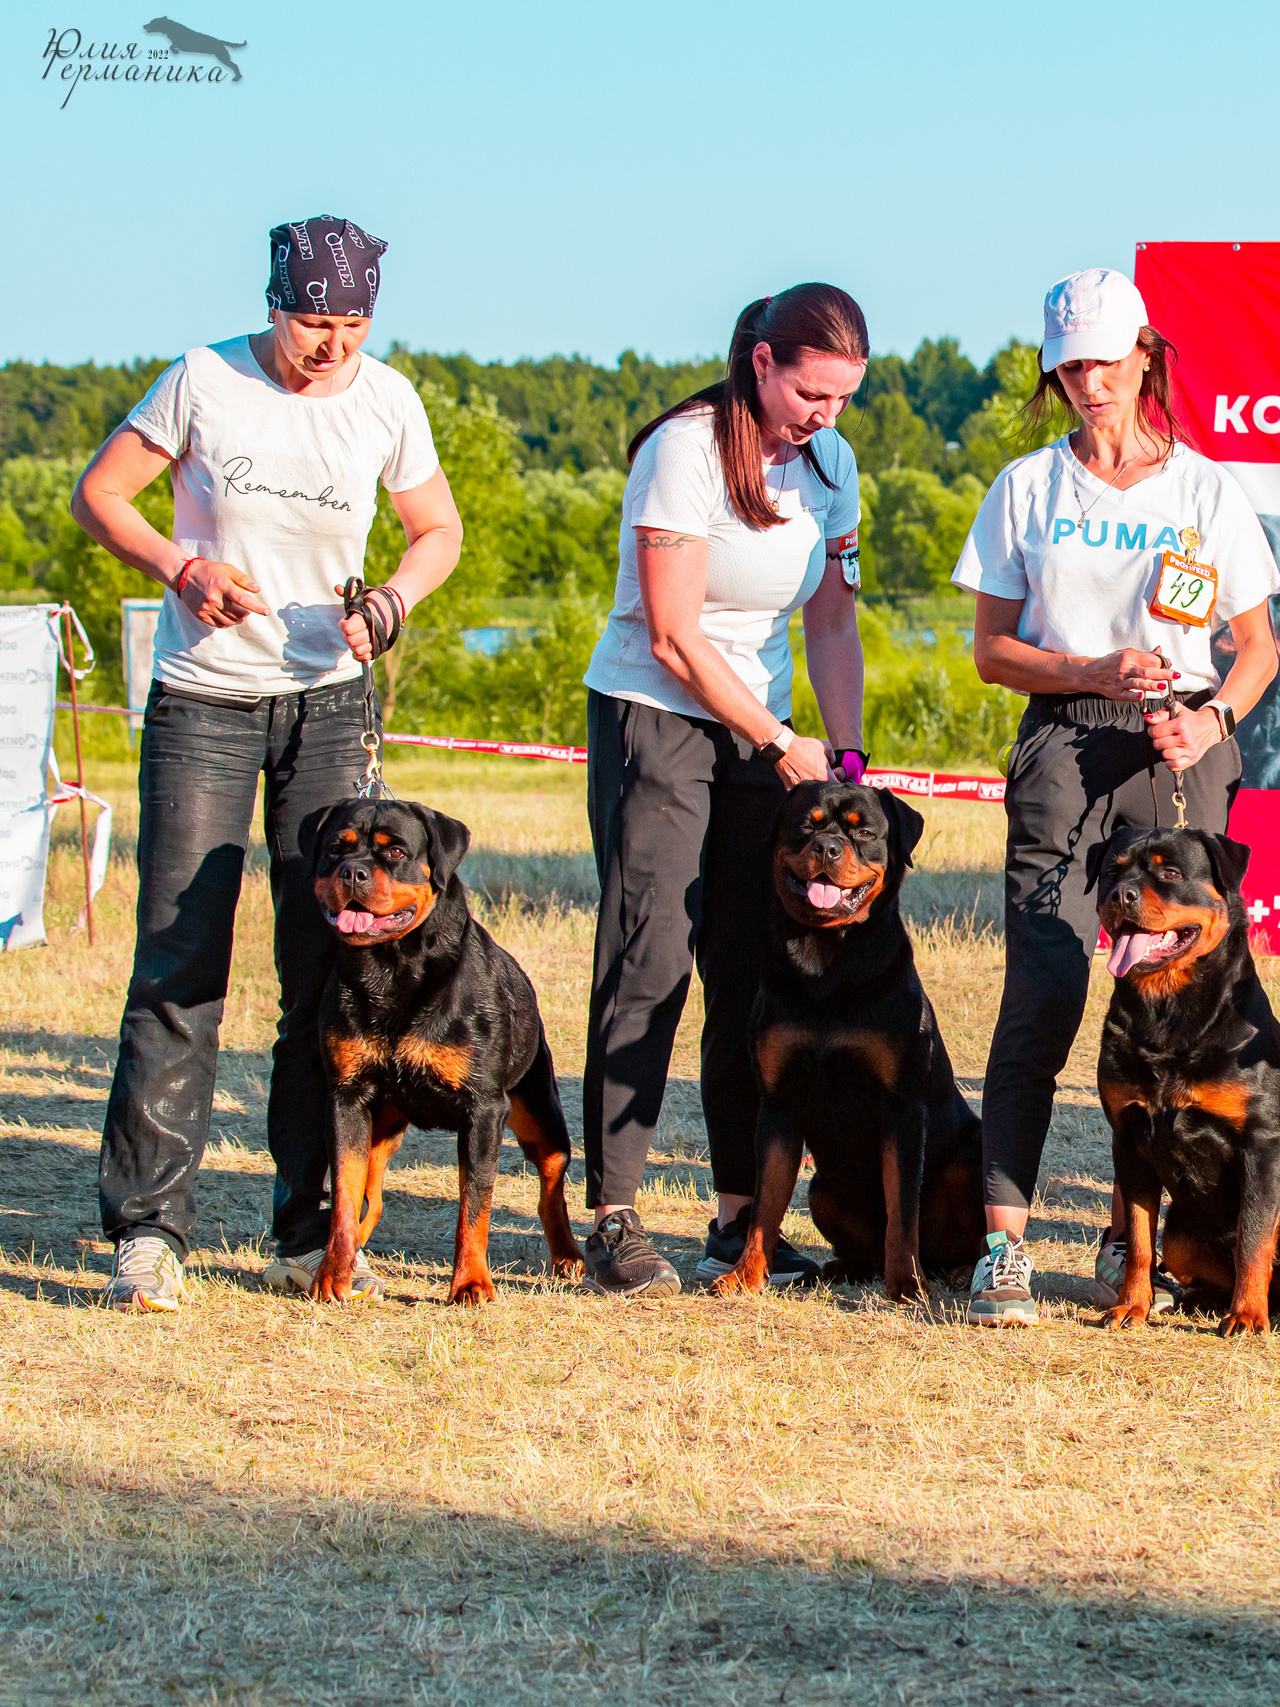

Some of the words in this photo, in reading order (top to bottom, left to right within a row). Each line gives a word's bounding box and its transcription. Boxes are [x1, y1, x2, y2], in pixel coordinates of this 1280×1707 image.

[289, 220, 314, 260] KLINI
[223, 456, 351, 512] Remember
[1052, 518, 1181, 552] PUMA
[1170, 572, 1204, 609] 49
